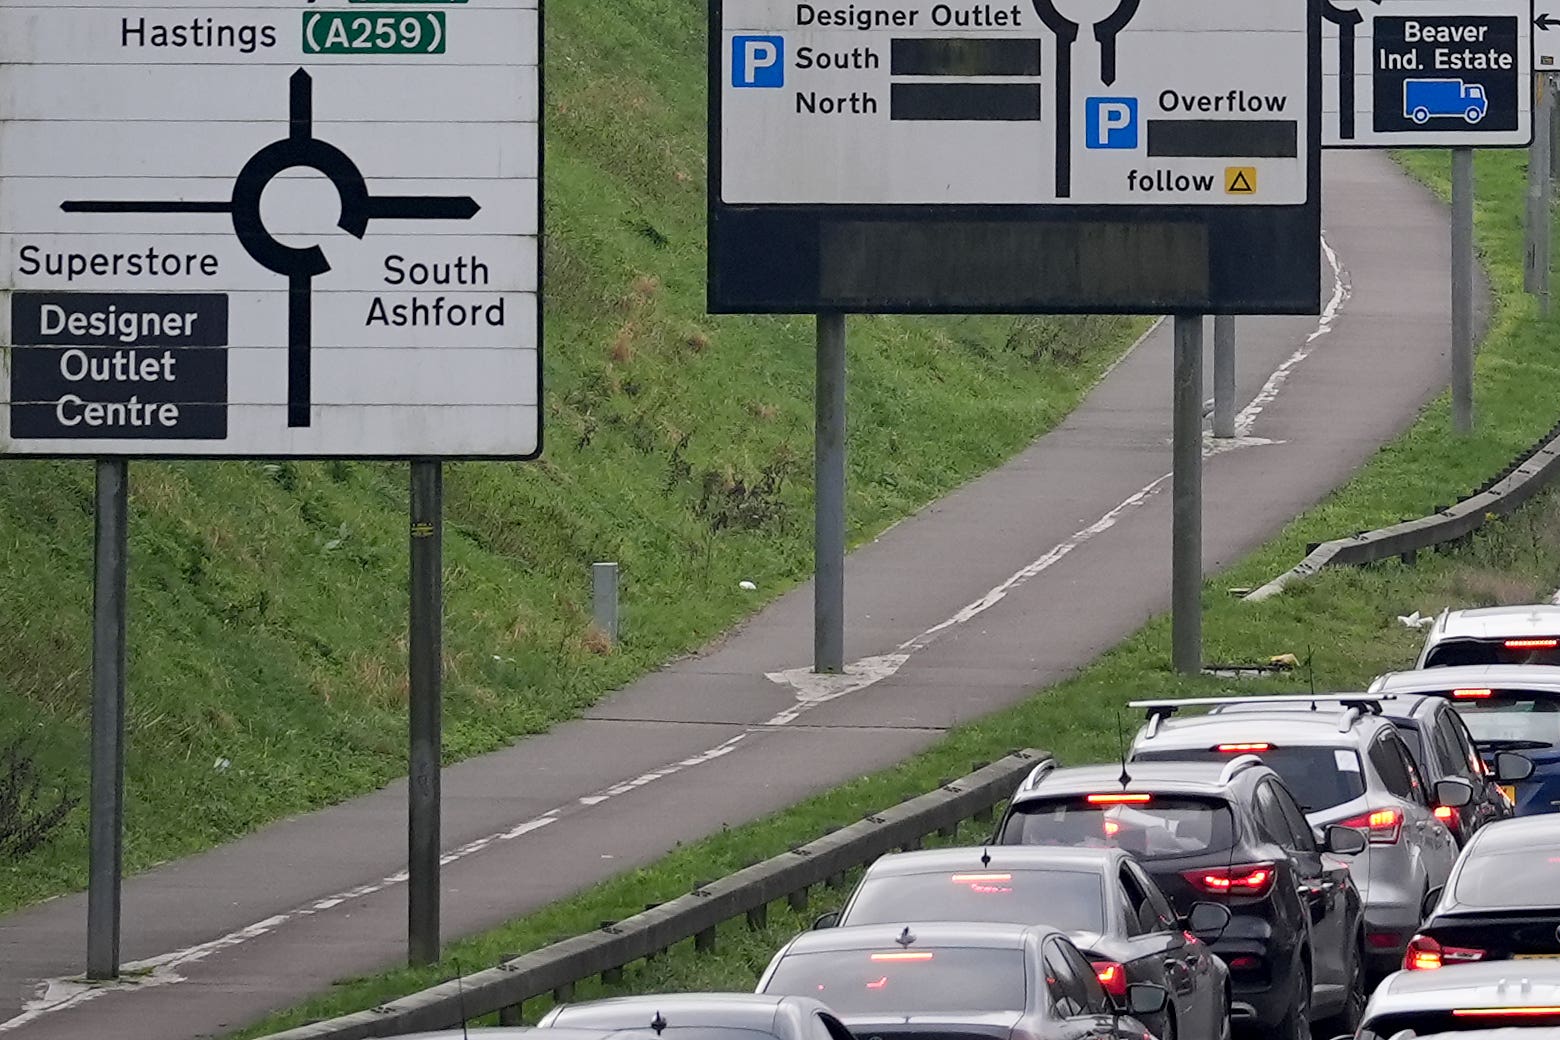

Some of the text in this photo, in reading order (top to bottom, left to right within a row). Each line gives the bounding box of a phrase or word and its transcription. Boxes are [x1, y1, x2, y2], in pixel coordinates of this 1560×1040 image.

[121, 12, 442, 54] Hastings (A259)
[796, 3, 1021, 31] Designer Outlet
[1405, 21, 1488, 43] Beaver
[744, 40, 777, 84] P
[795, 47, 879, 69] South
[1379, 48, 1512, 71] Ind. Estate
[796, 91, 877, 114] North
[1158, 89, 1288, 112] Overflow
[1098, 102, 1131, 145] P
[1127, 168, 1214, 193] follow
[18, 245, 219, 281] Superstore
[383, 254, 489, 286] South
[40, 305, 198, 339] Designer
[365, 296, 505, 328] Ashford
[60, 348, 176, 382] Outlet
[55, 393, 179, 428] Centre
